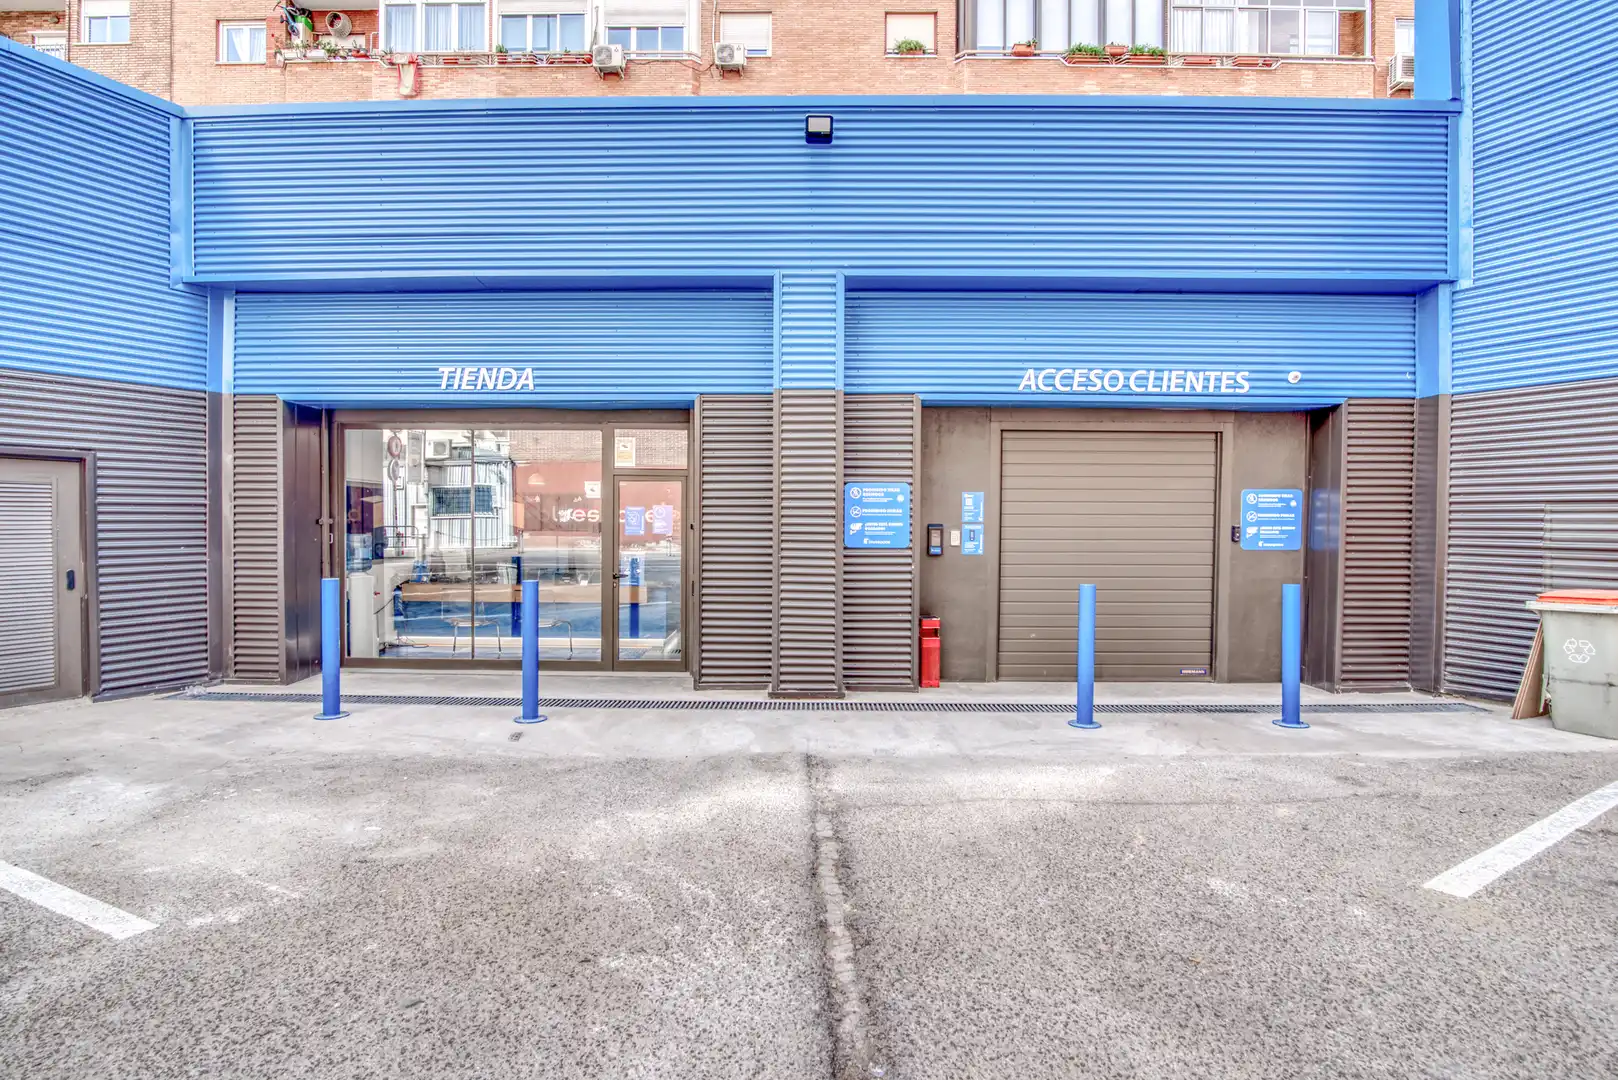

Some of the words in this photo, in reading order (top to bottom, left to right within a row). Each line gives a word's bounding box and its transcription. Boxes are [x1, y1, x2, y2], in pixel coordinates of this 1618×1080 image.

[438, 367, 535, 391] TIENDA
[1018, 368, 1124, 392] ACCESO
[1129, 370, 1250, 393] CLIENTES
